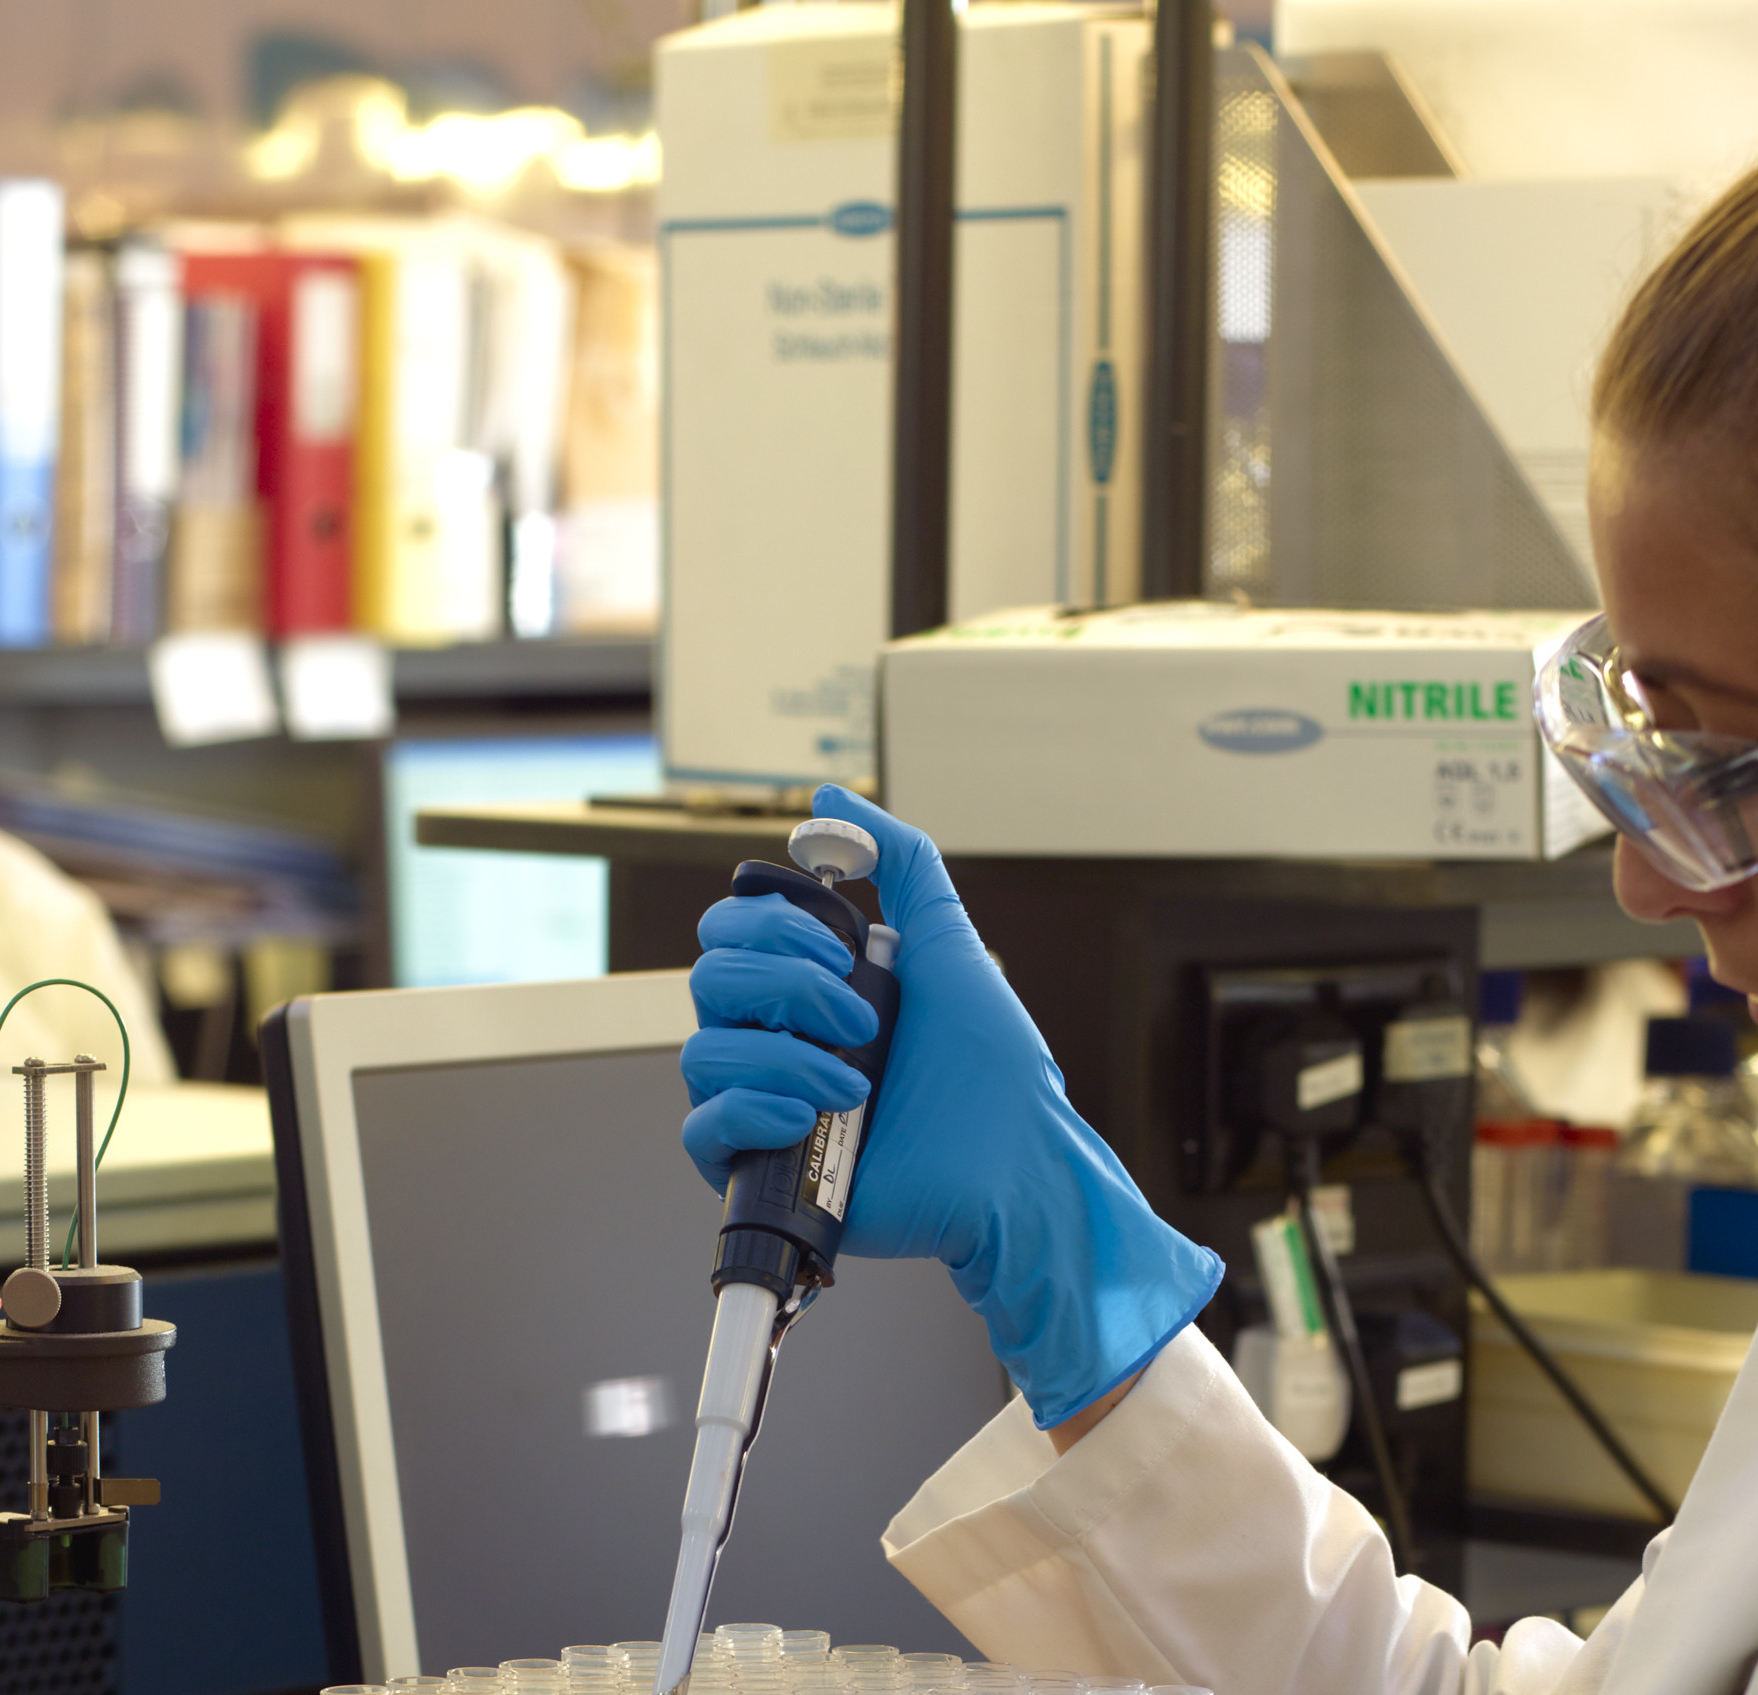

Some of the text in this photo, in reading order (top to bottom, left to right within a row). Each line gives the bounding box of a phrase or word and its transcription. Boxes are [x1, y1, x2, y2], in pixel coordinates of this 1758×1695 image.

[1348, 681, 1519, 721] NITRILE
[808, 1111, 832, 1182] CALIBRAT
[837, 1127, 847, 1148] DATE
[825, 1199, 832, 1209] BY
